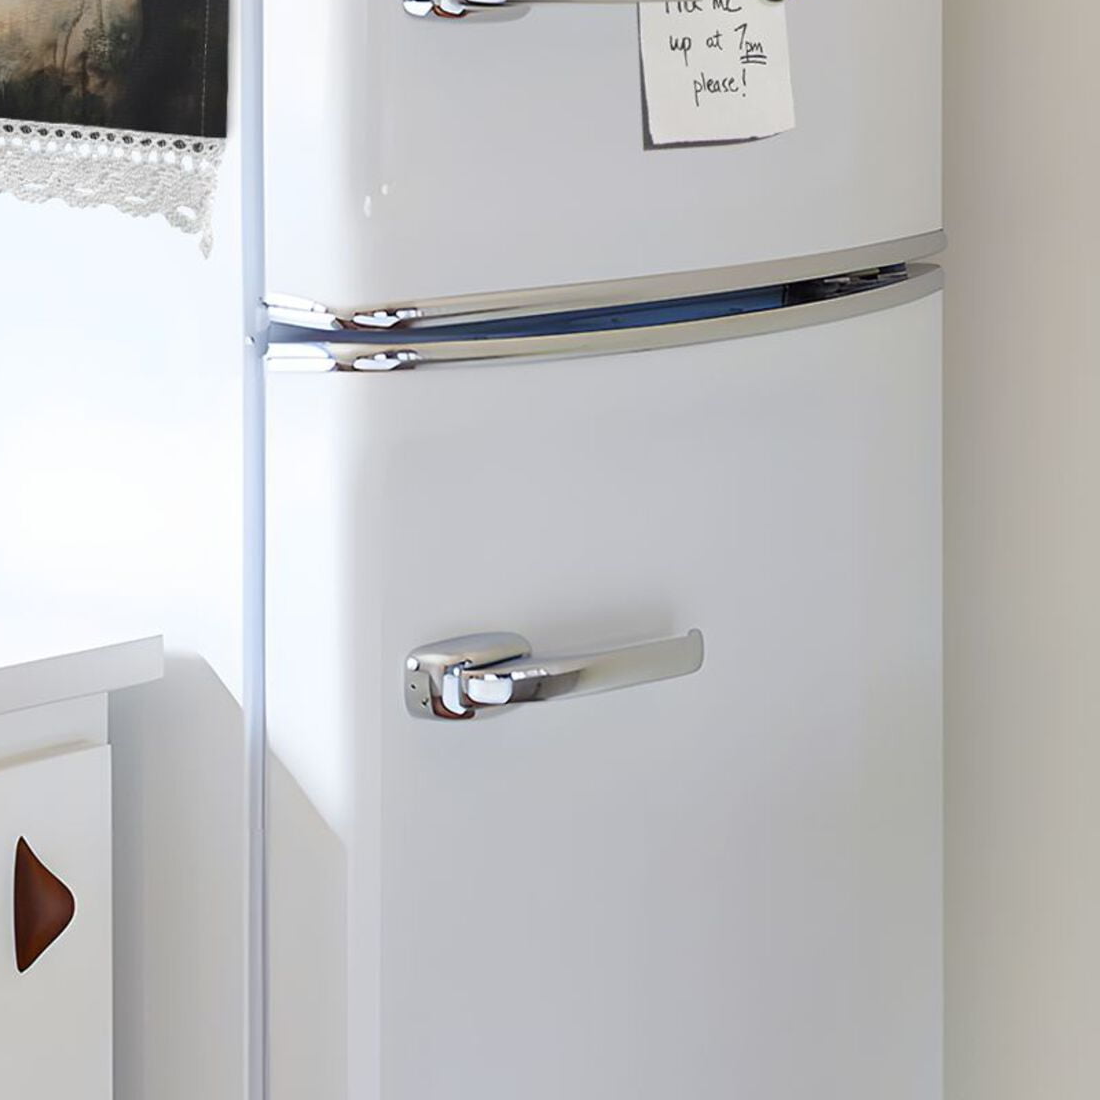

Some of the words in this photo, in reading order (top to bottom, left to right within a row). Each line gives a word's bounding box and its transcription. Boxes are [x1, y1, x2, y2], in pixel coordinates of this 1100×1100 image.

[668, 34, 692, 67] up
[705, 29, 724, 51] at
[692, 67, 747, 108] please!
